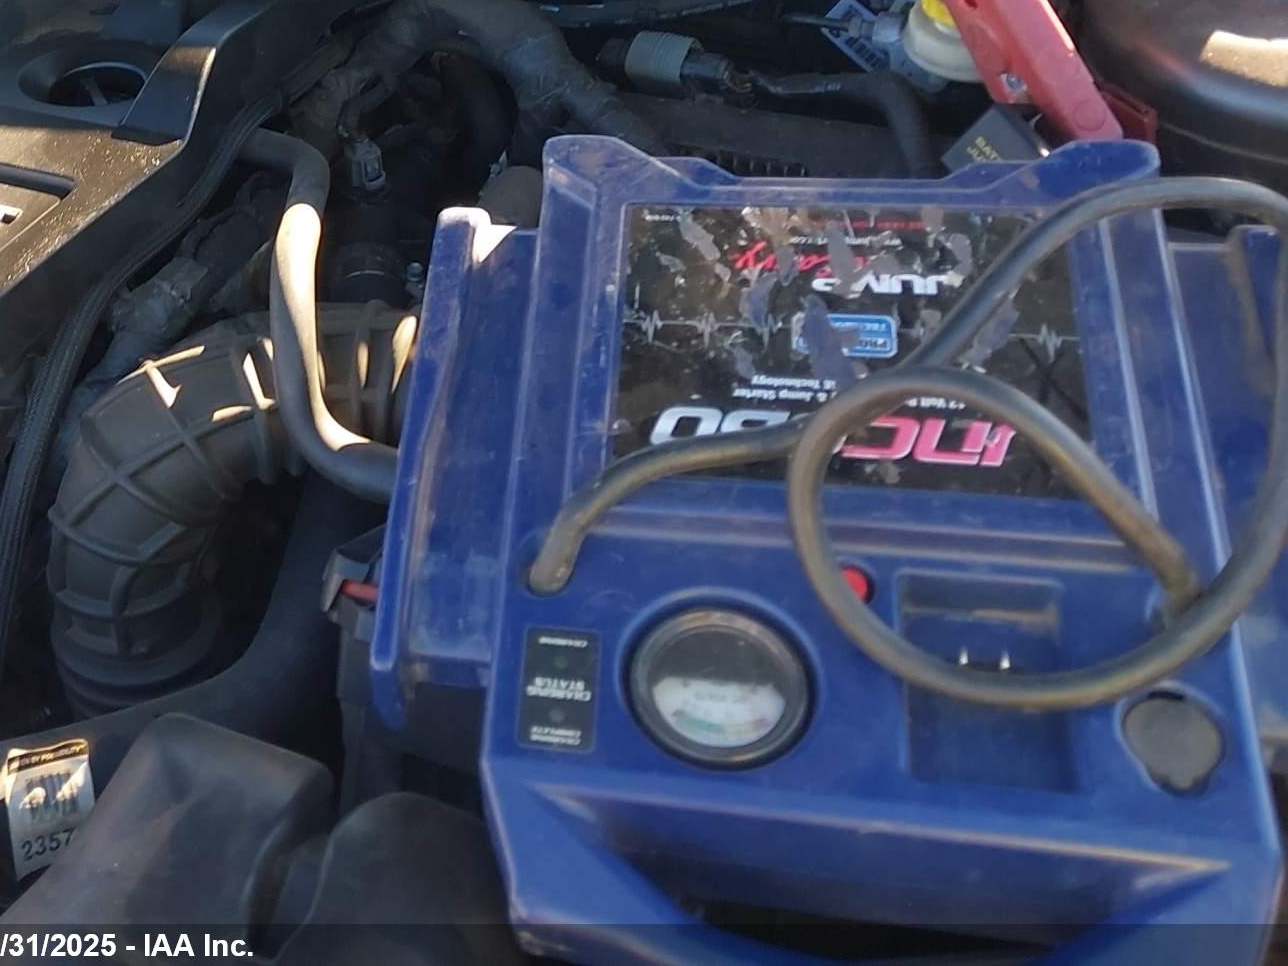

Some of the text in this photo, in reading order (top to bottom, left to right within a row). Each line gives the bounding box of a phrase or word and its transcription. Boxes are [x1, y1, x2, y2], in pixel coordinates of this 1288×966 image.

[750, 375, 821, 390] Technology
[731, 388, 777, 401] Starter
[779, 389, 814, 403] Jump
[534, 676, 586, 691] STATUS
[525, 685, 593, 702] CHARGING
[530, 725, 583, 738] COMPLETE
[530, 733, 582, 746] CHARGING
